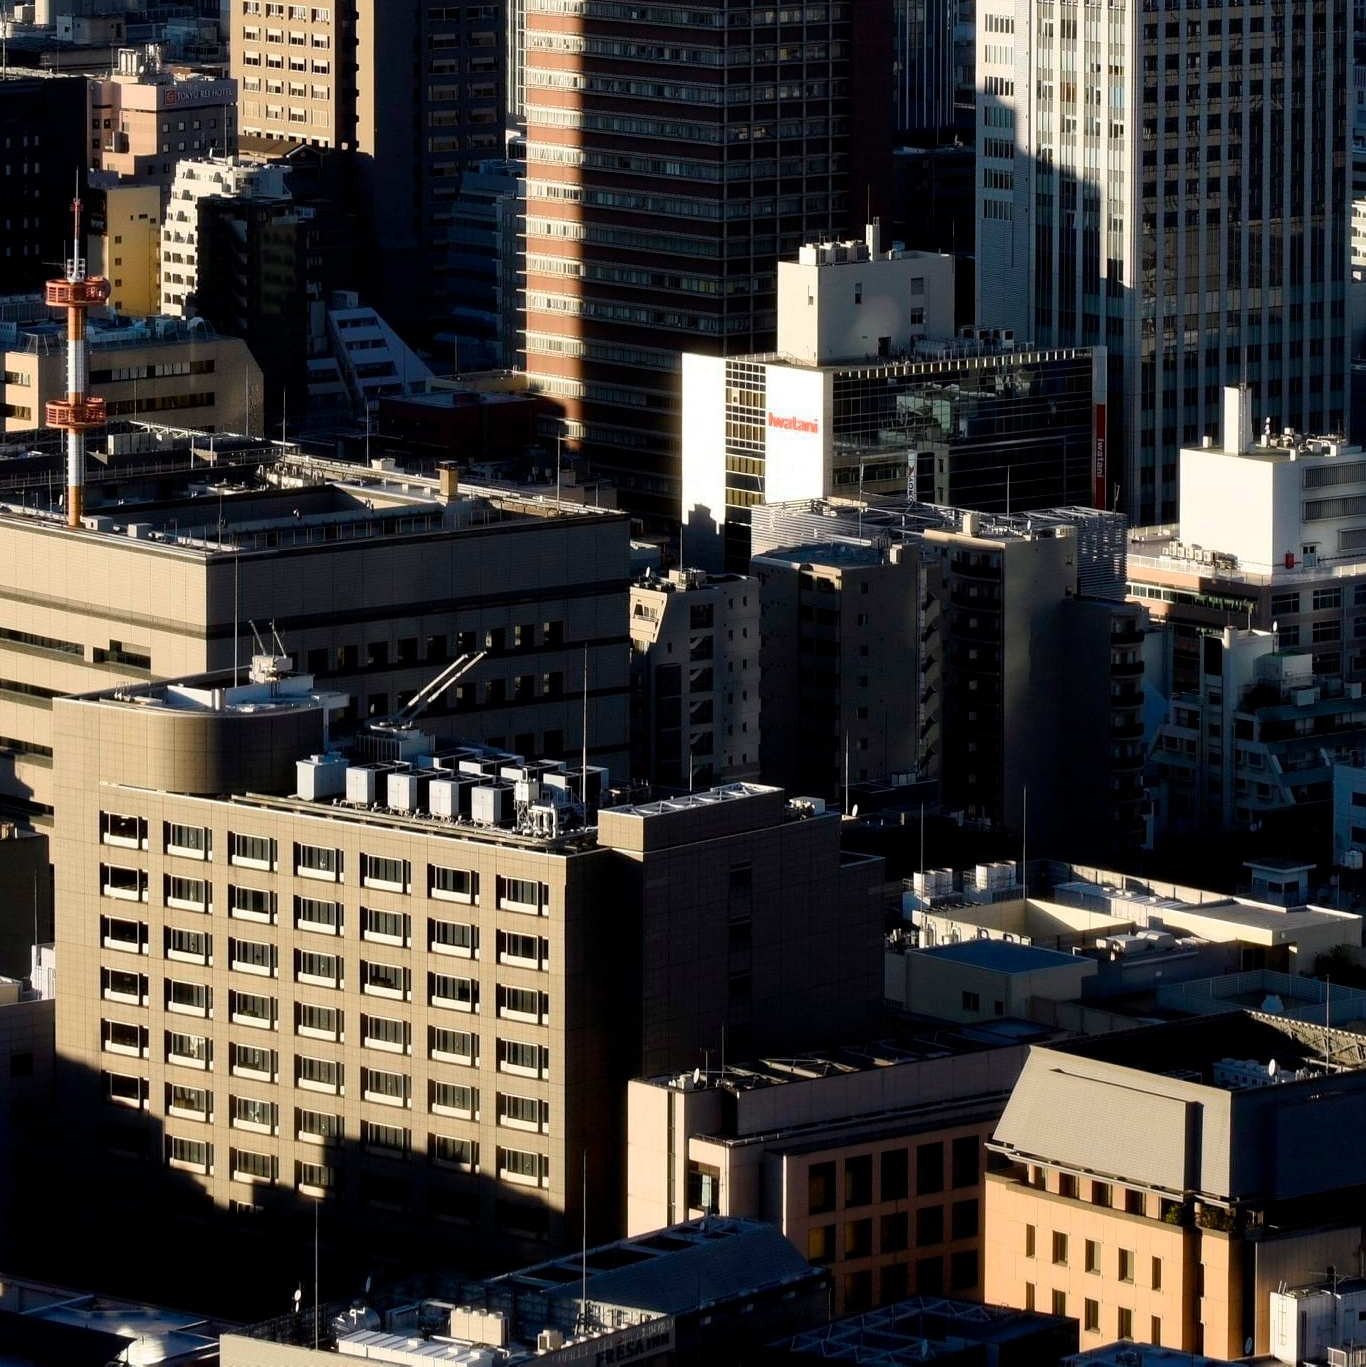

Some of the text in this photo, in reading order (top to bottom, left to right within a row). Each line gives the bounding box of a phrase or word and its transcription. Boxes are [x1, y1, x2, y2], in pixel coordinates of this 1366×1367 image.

[176, 91, 200, 102] TOKYU
[212, 87, 233, 97] HOTEL
[768, 412, 819, 434] Iwatani
[1096, 438, 1105, 479] Iwatani
